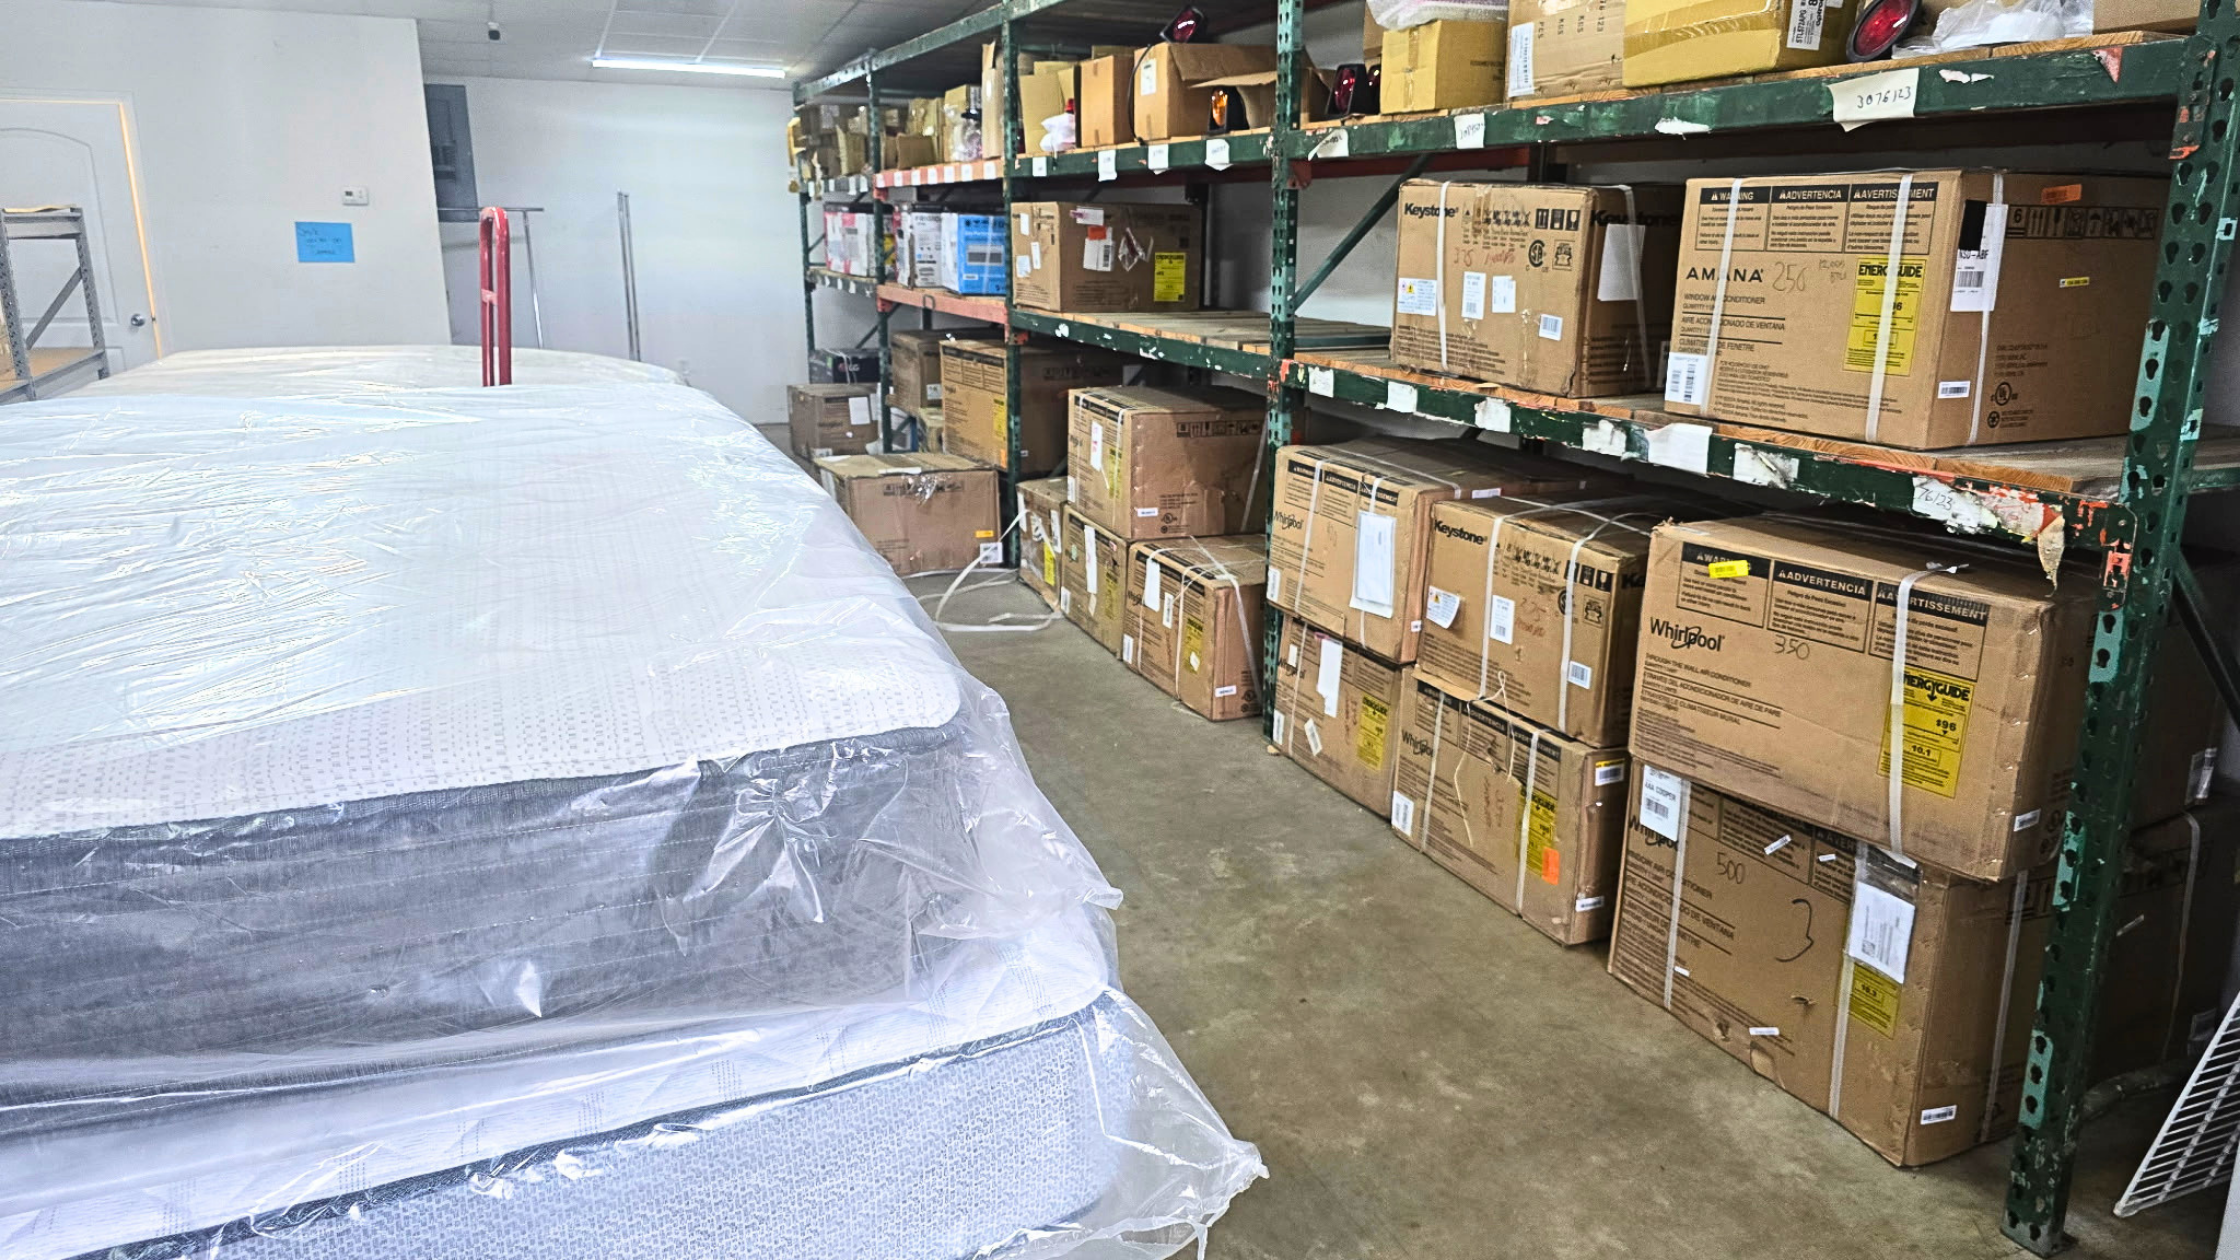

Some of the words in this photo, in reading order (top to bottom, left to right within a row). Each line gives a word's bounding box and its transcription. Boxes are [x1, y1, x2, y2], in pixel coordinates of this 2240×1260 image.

[1857, 86, 1912, 109] 3076123
[1720, 191, 1754, 201] WANING
[1786, 189, 1842, 200] ADVERTENCIA
[1860, 188, 1934, 199] AVERTISMENT
[1404, 203, 1456, 219] Keystoe
[1434, 519, 1484, 546] Keystone
[1786, 570, 1867, 596] ADVERTENCIA
[1886, 591, 1987, 621] ARTISSEMENT
[1650, 617, 1722, 651] Whirlpool
[1774, 634, 1810, 660] 350
[1904, 673, 1970, 702] NERGYGUIDE
[1936, 719, 1957, 732] $96
[1912, 745, 1931, 757] 10.1
[1717, 852, 1745, 885] 500
